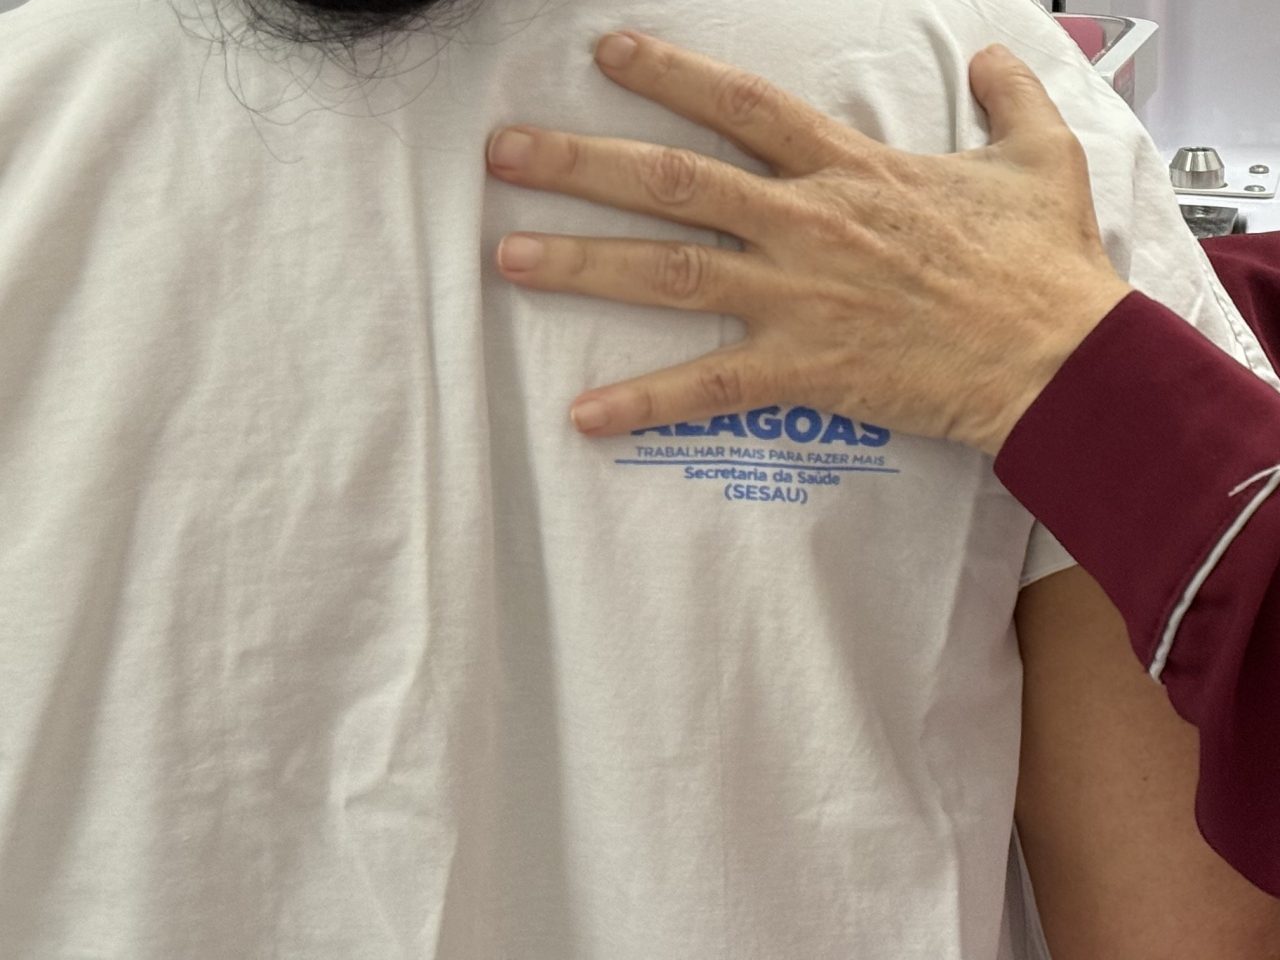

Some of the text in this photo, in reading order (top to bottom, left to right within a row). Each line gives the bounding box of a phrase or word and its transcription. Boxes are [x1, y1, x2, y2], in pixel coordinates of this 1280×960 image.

[635, 446, 885, 466] TRABALHAR MAIS PARA FAZER MAIS
[684, 465, 841, 486] Secretaria da Saúde
[724, 483, 808, 505] (SESAU)
